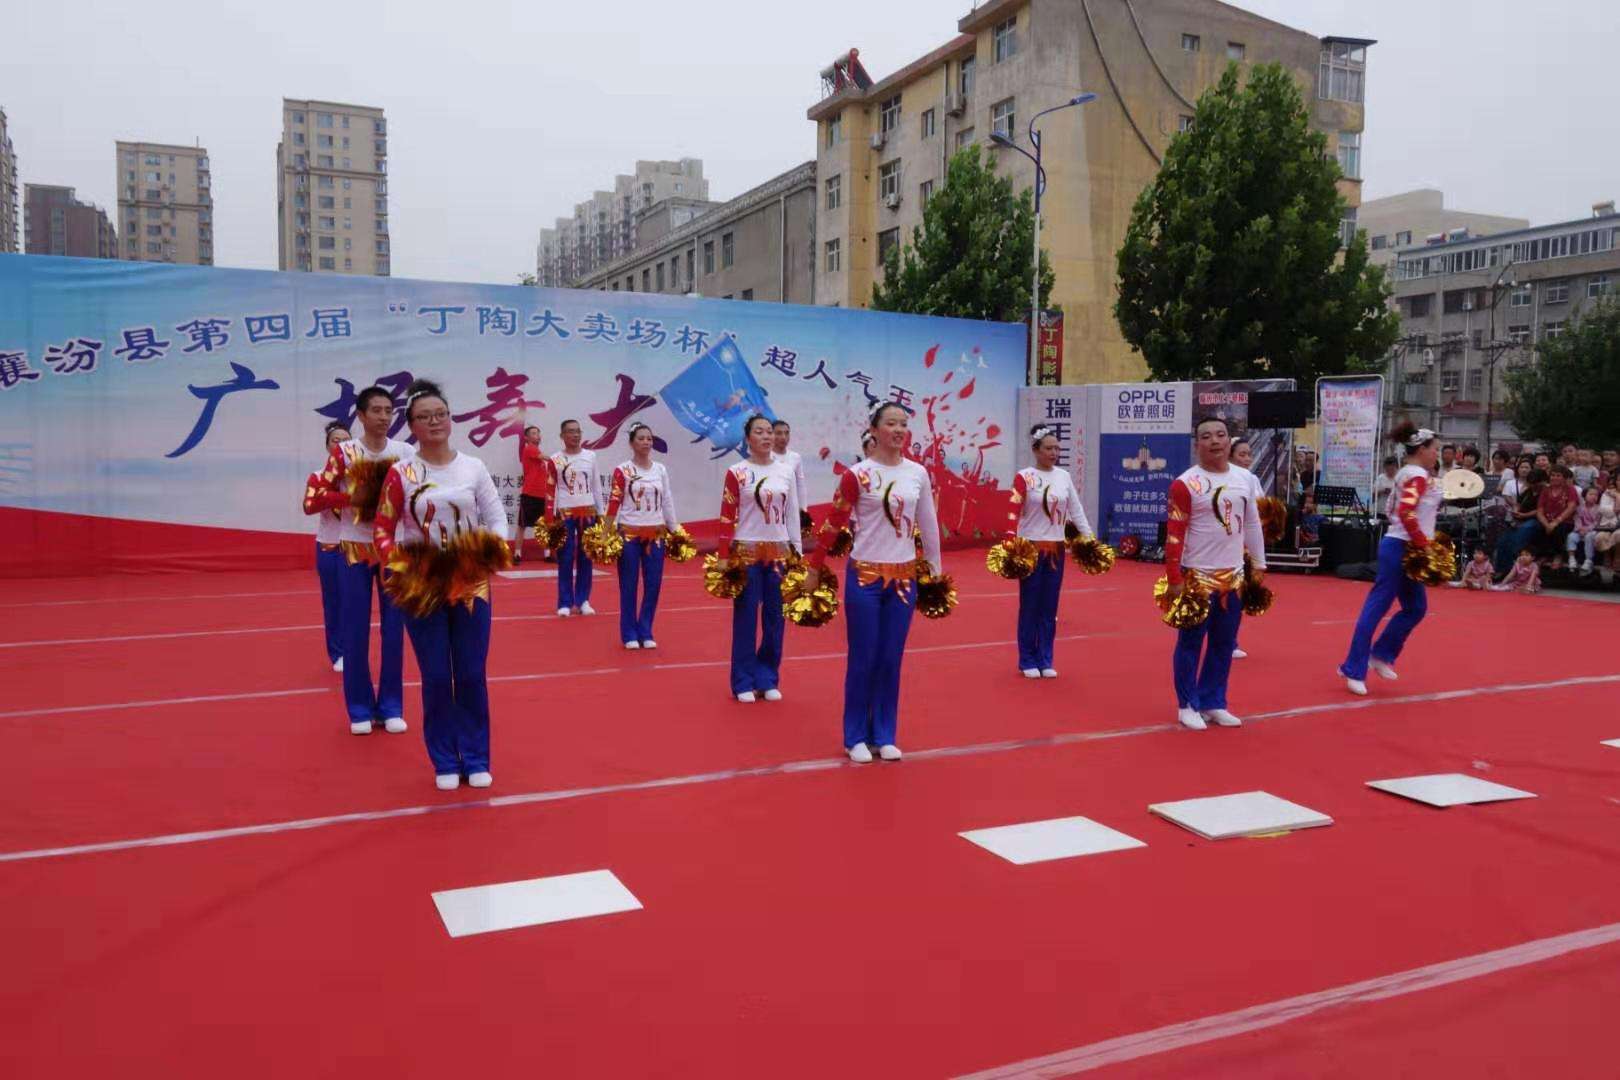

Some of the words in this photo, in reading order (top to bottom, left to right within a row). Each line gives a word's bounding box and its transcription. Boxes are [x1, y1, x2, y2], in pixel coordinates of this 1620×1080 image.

[1119, 389, 1176, 403] OPPLE
[1118, 404, 1175, 419] 欧普照明
